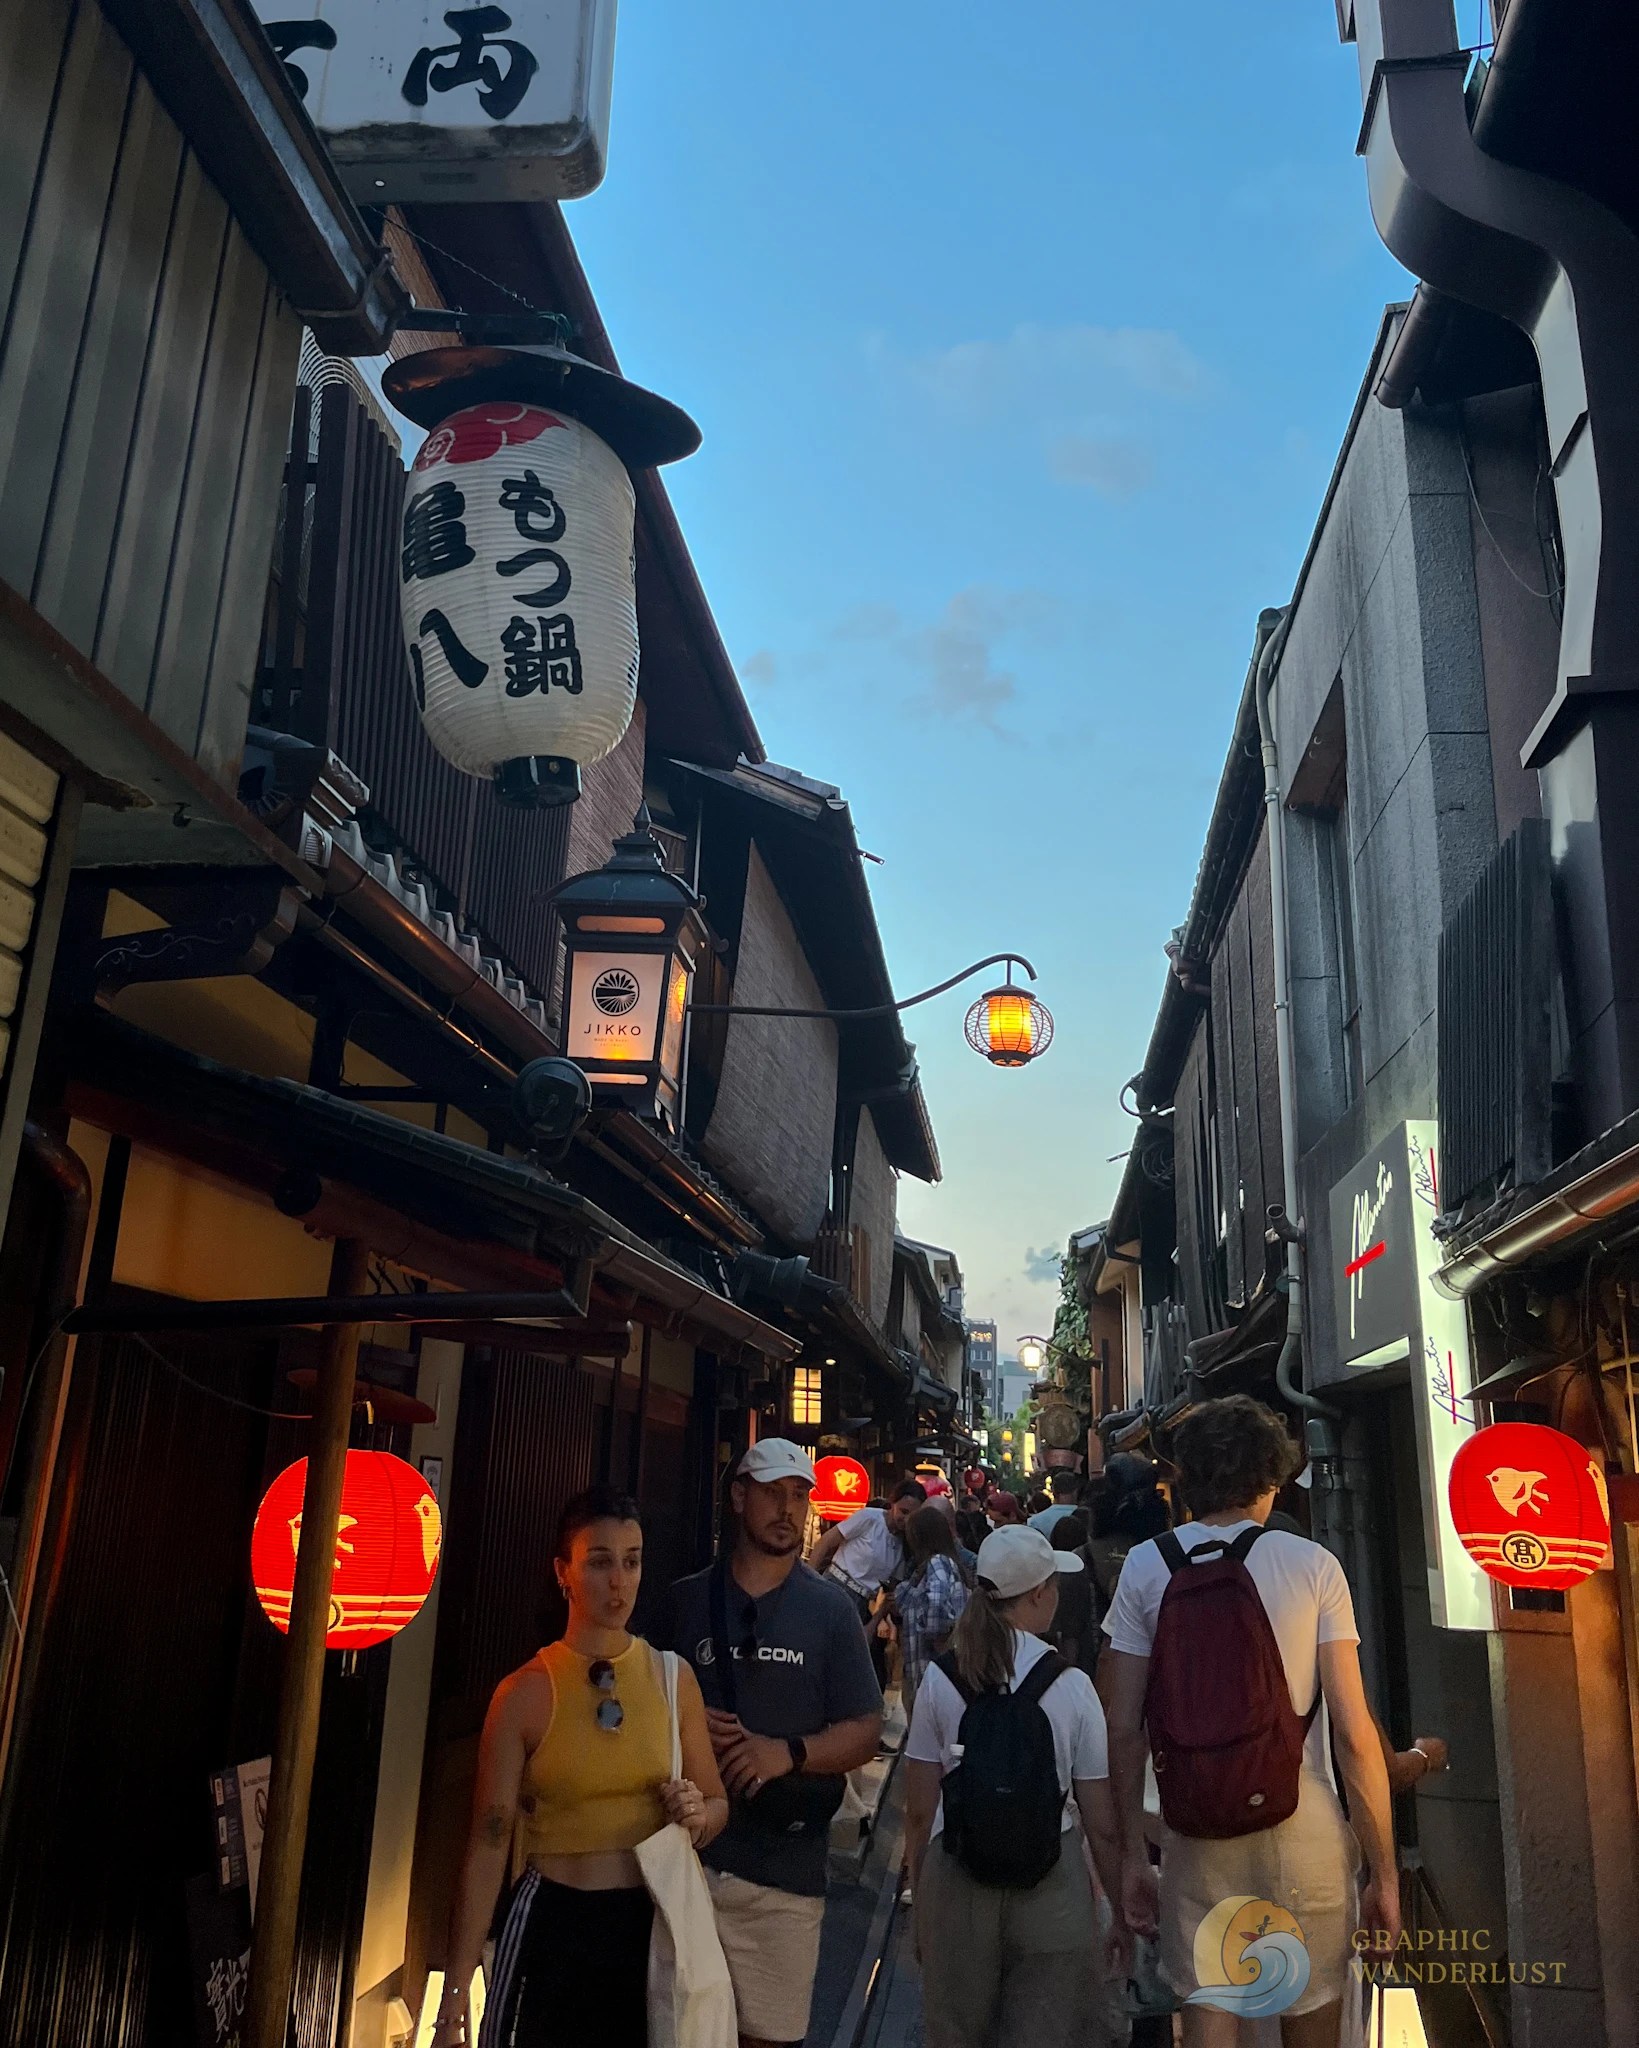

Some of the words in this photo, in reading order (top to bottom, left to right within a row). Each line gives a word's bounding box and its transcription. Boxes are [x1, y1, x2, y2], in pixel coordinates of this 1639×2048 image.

[496, 470, 583, 696] もつ鍋
[584, 1023, 641, 1036] JIKKO
